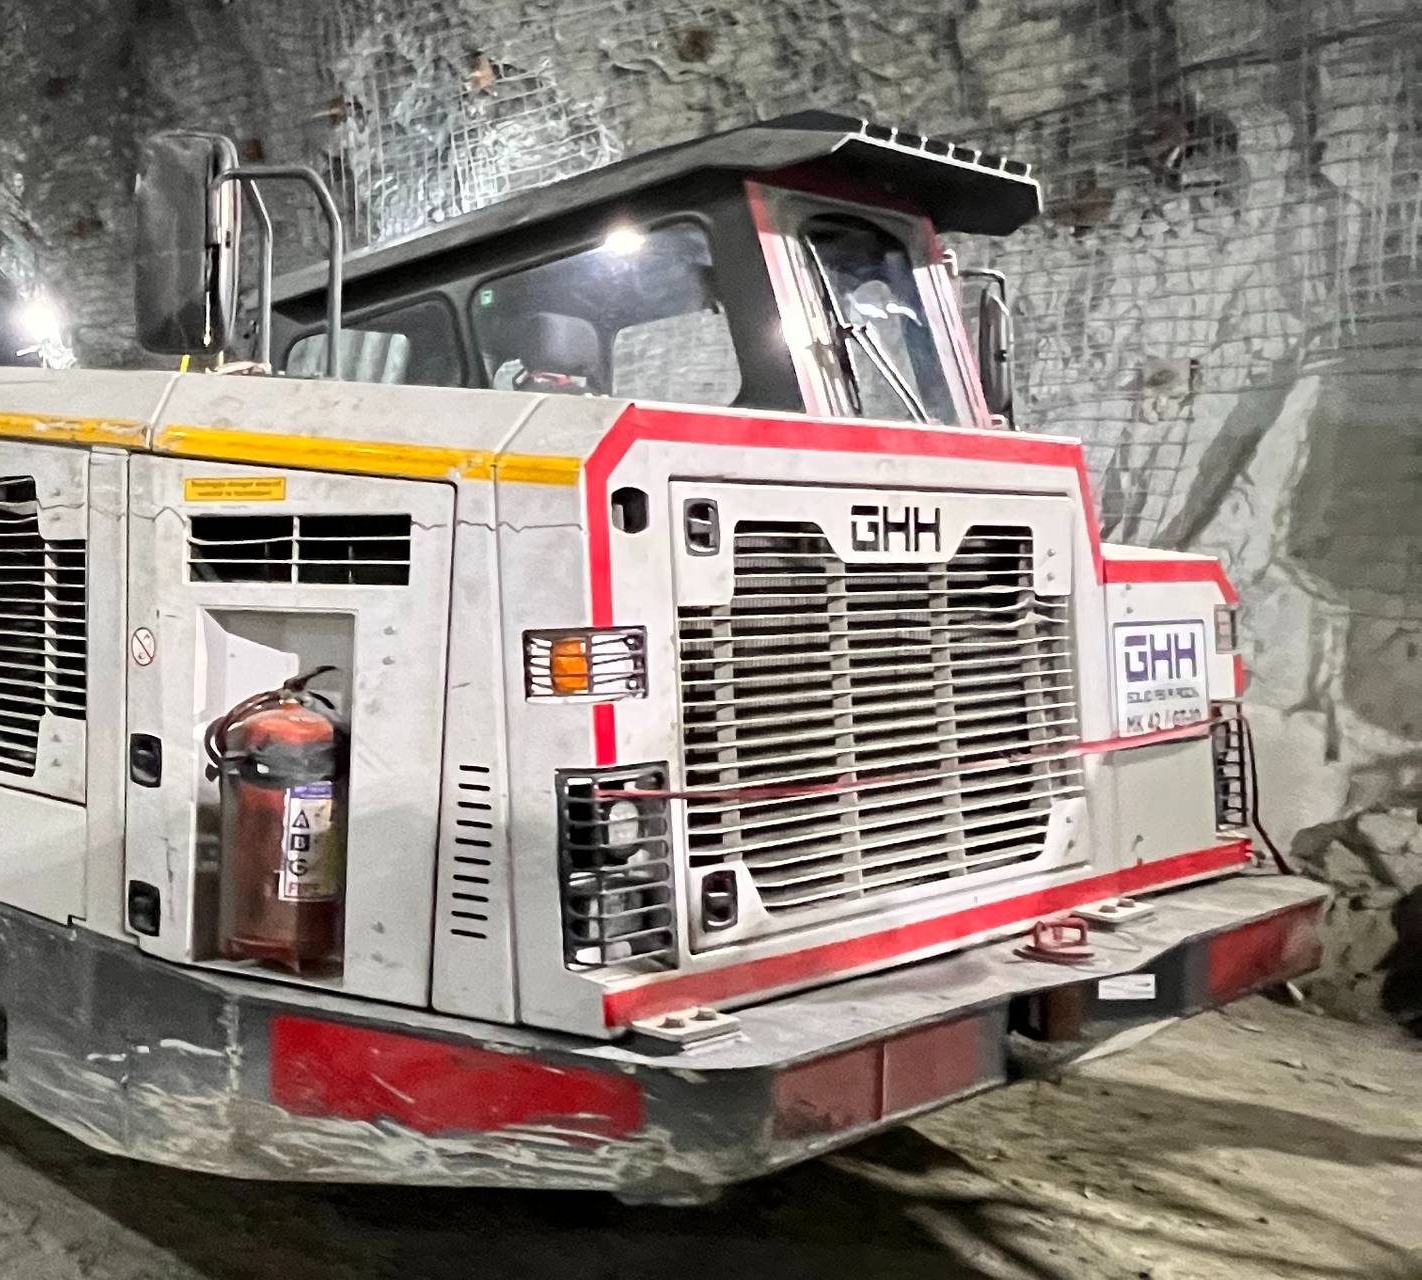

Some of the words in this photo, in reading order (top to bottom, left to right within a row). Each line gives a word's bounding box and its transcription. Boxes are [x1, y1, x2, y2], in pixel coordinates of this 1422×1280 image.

[850, 504, 941, 553] GHH
[1124, 632, 1197, 682] GHH
[1127, 714, 1144, 733] MK
